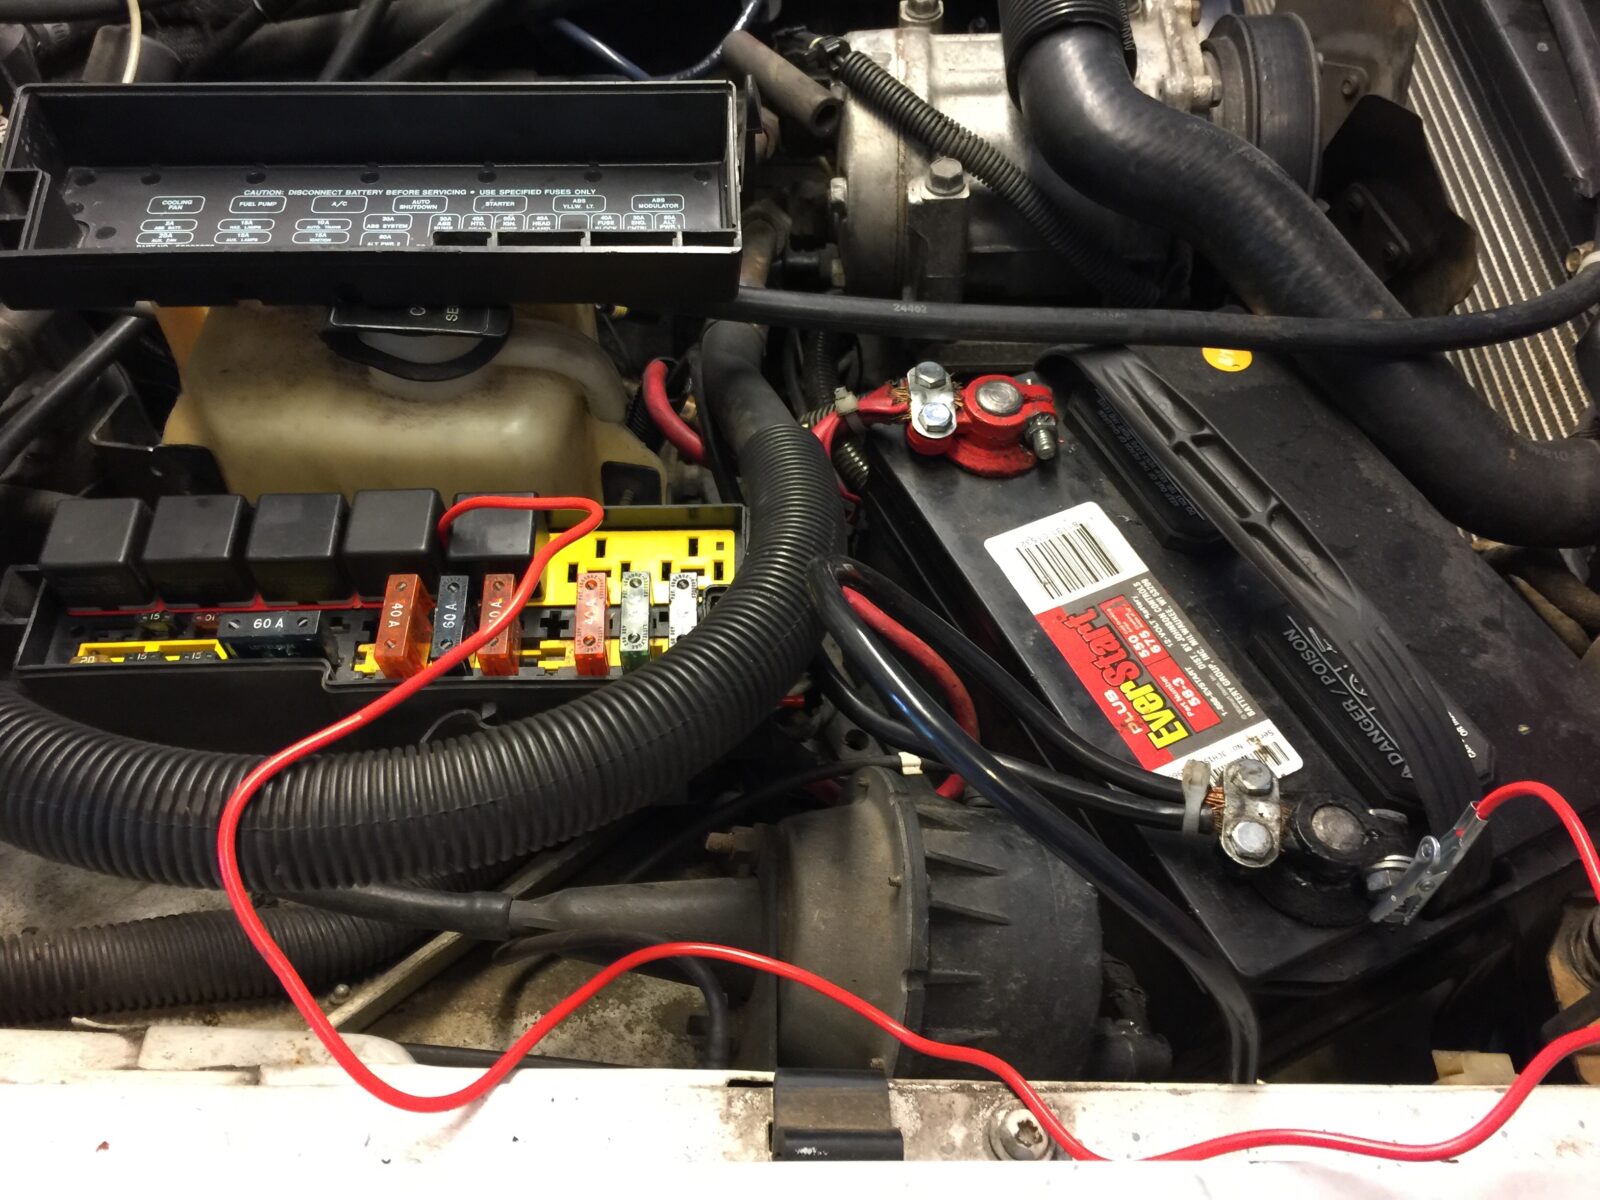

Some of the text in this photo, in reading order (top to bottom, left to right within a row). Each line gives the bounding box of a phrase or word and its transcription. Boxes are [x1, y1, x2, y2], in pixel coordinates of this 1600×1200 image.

[893, 303, 928, 314] 24402
[1154, 595, 1167, 606] WI
[253, 618, 284, 629] 60 A
[1132, 580, 1207, 670] DIST. BY JOHNSON CONTROLS
[1147, 617, 1175, 647] 12-VOLT
[1162, 605, 1199, 646] MILWAUKEE,
[1126, 633, 1151, 659] 550
[1137, 628, 1163, 654] 675
[1194, 645, 1211, 661] INC.
[1282, 626, 1337, 686] POISON
[1055, 606, 1193, 750] EverStart
[1205, 659, 1232, 687] GROUP,
[1157, 673, 1195, 717] Part Number
[1169, 675, 1202, 707] 58-3
[1226, 685, 1256, 717] BATTERY
[1100, 688, 1145, 735] PLUS
[1340, 696, 1403, 766] DANGER
